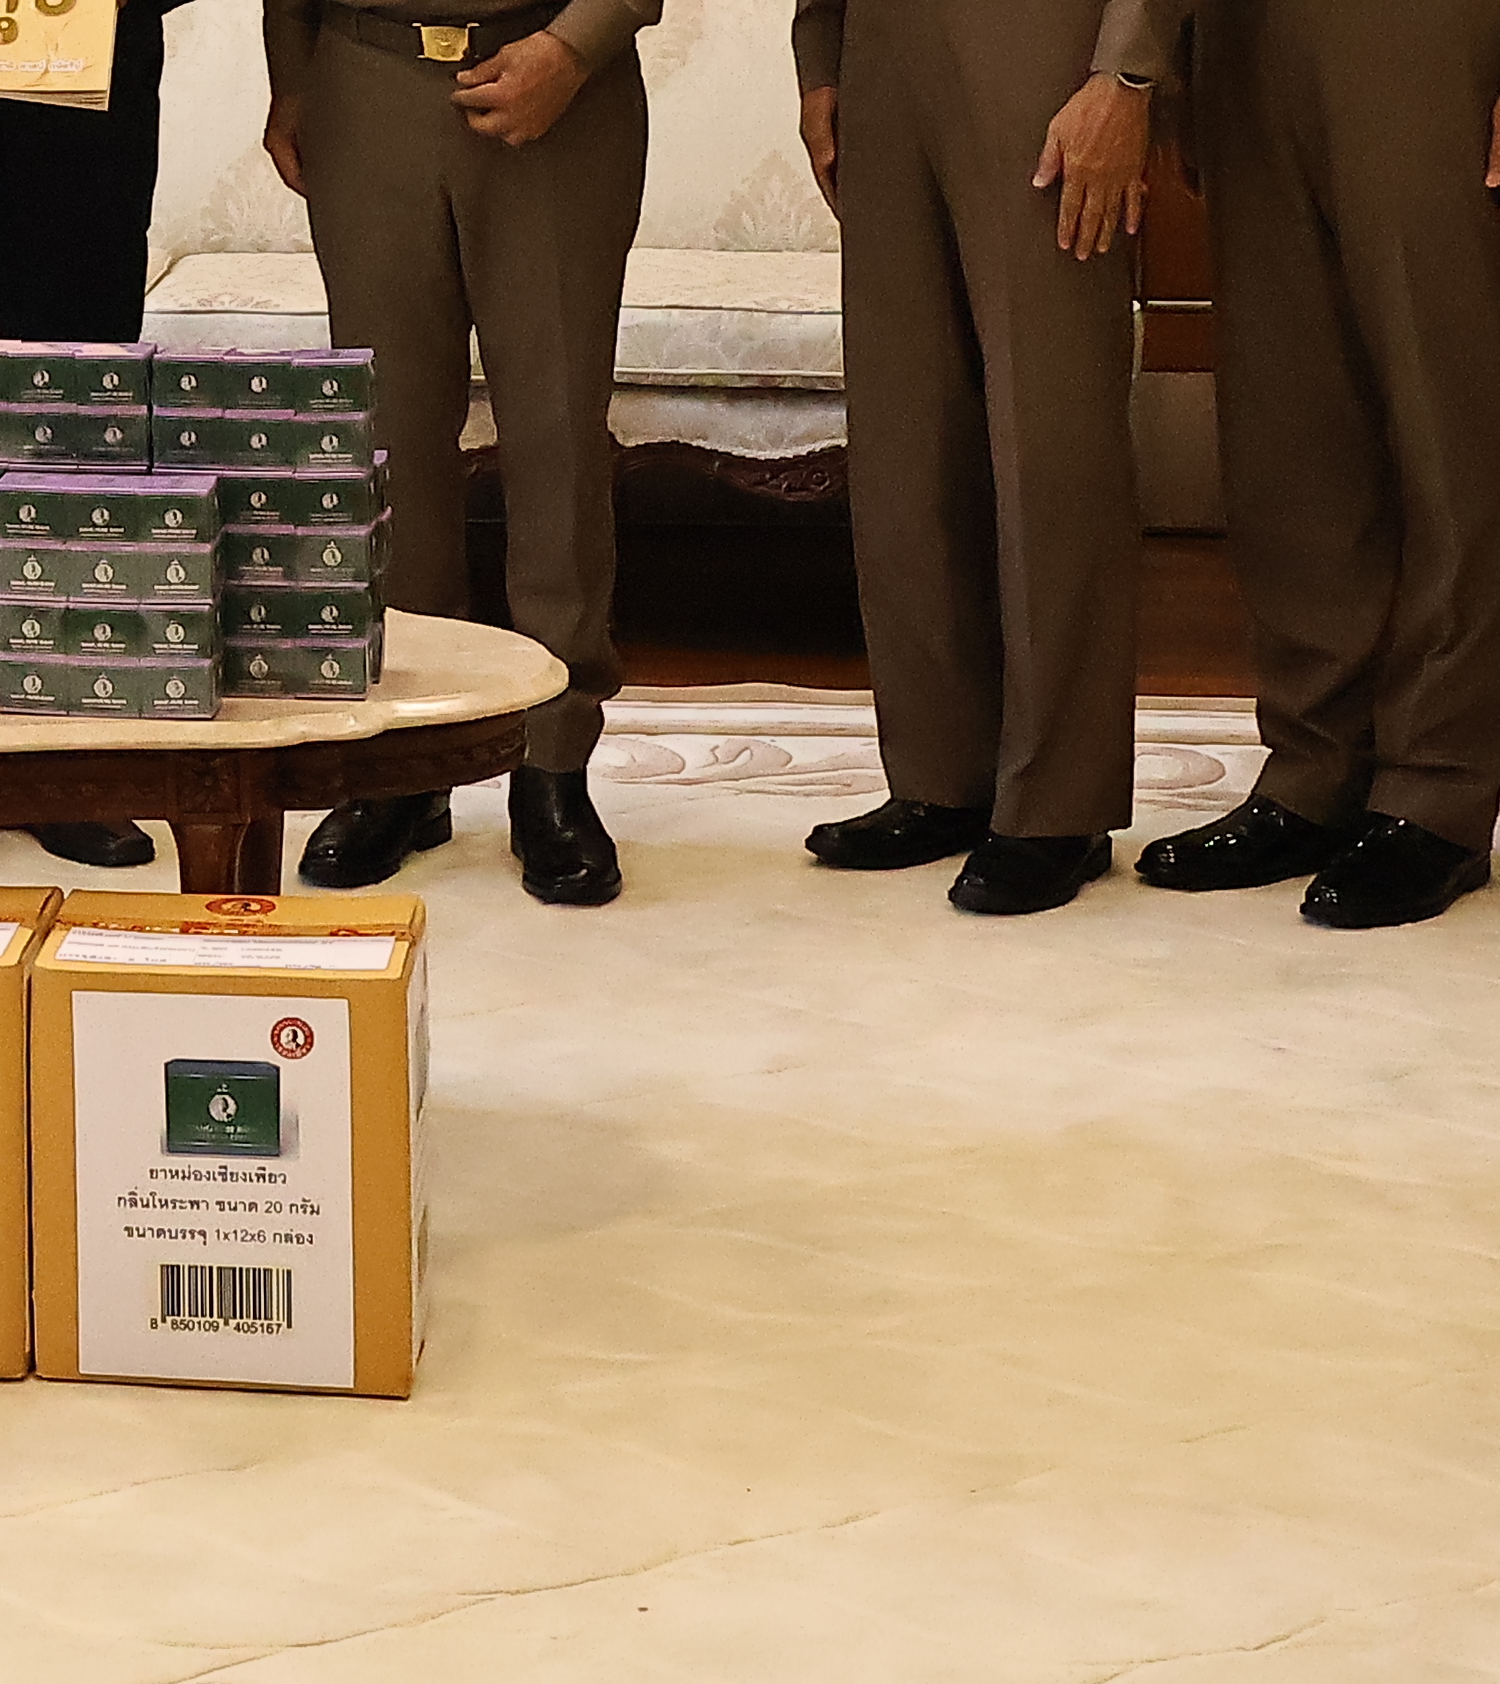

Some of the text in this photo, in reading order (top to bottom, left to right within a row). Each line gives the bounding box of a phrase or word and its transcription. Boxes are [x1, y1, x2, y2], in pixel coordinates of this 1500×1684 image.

[215, 1200, 258, 1213] ขนาด
[264, 1200, 283, 1214] 20
[288, 1197, 321, 1216] กรัม
[123, 1225, 314, 1246] ขนาดบรรจุ 1x12x6 กล่อง
[150, 1318, 283, 1334] 8 850109 405167
